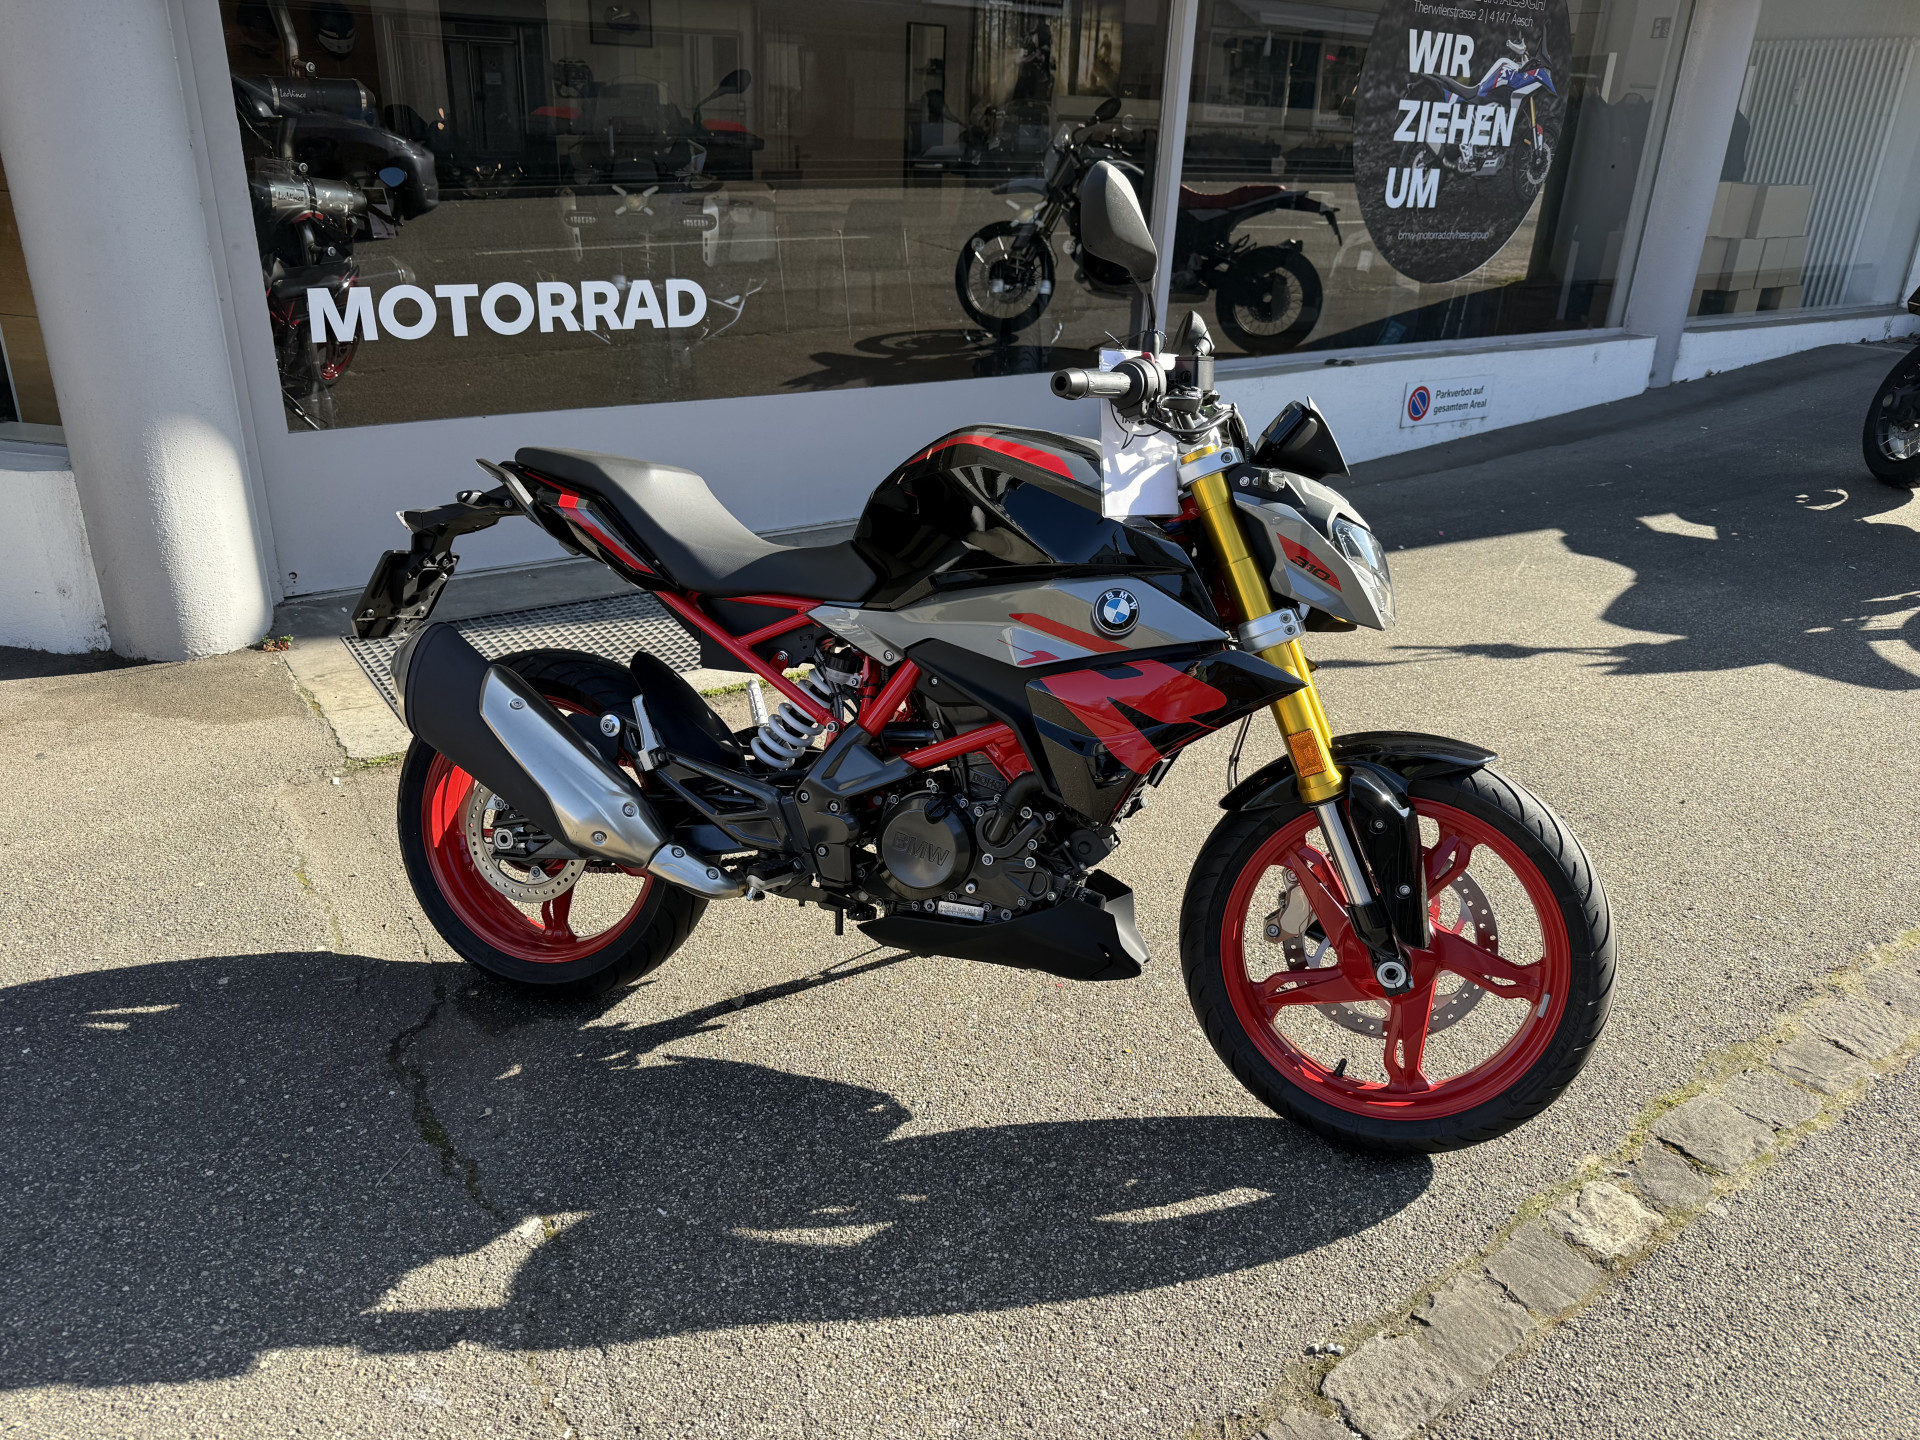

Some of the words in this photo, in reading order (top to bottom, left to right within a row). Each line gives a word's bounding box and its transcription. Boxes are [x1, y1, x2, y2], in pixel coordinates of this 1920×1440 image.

[1414, 0, 1477, 20] Therwilerstrasse
[1478, 8, 1484, 21] 2
[1489, 9, 1511, 24] 4147
[1511, 13, 1534, 27] Aesch
[1408, 28, 1475, 78] WIR
[279, 88, 307, 99] LeoVince
[1393, 100, 1517, 147] ZIEHEN
[1384, 167, 1440, 209] UM
[306, 278, 708, 344] MOTORRAD
[1435, 387, 1472, 399] Parkverbot
[1473, 385, 1485, 395] auf
[1433, 402, 1468, 415] gesamtem
[1469, 399, 1487, 409] Areal
[1290, 555, 1331, 581] 310
[1105, 591, 1138, 610] BMW
[893, 831, 950, 867] BMW
